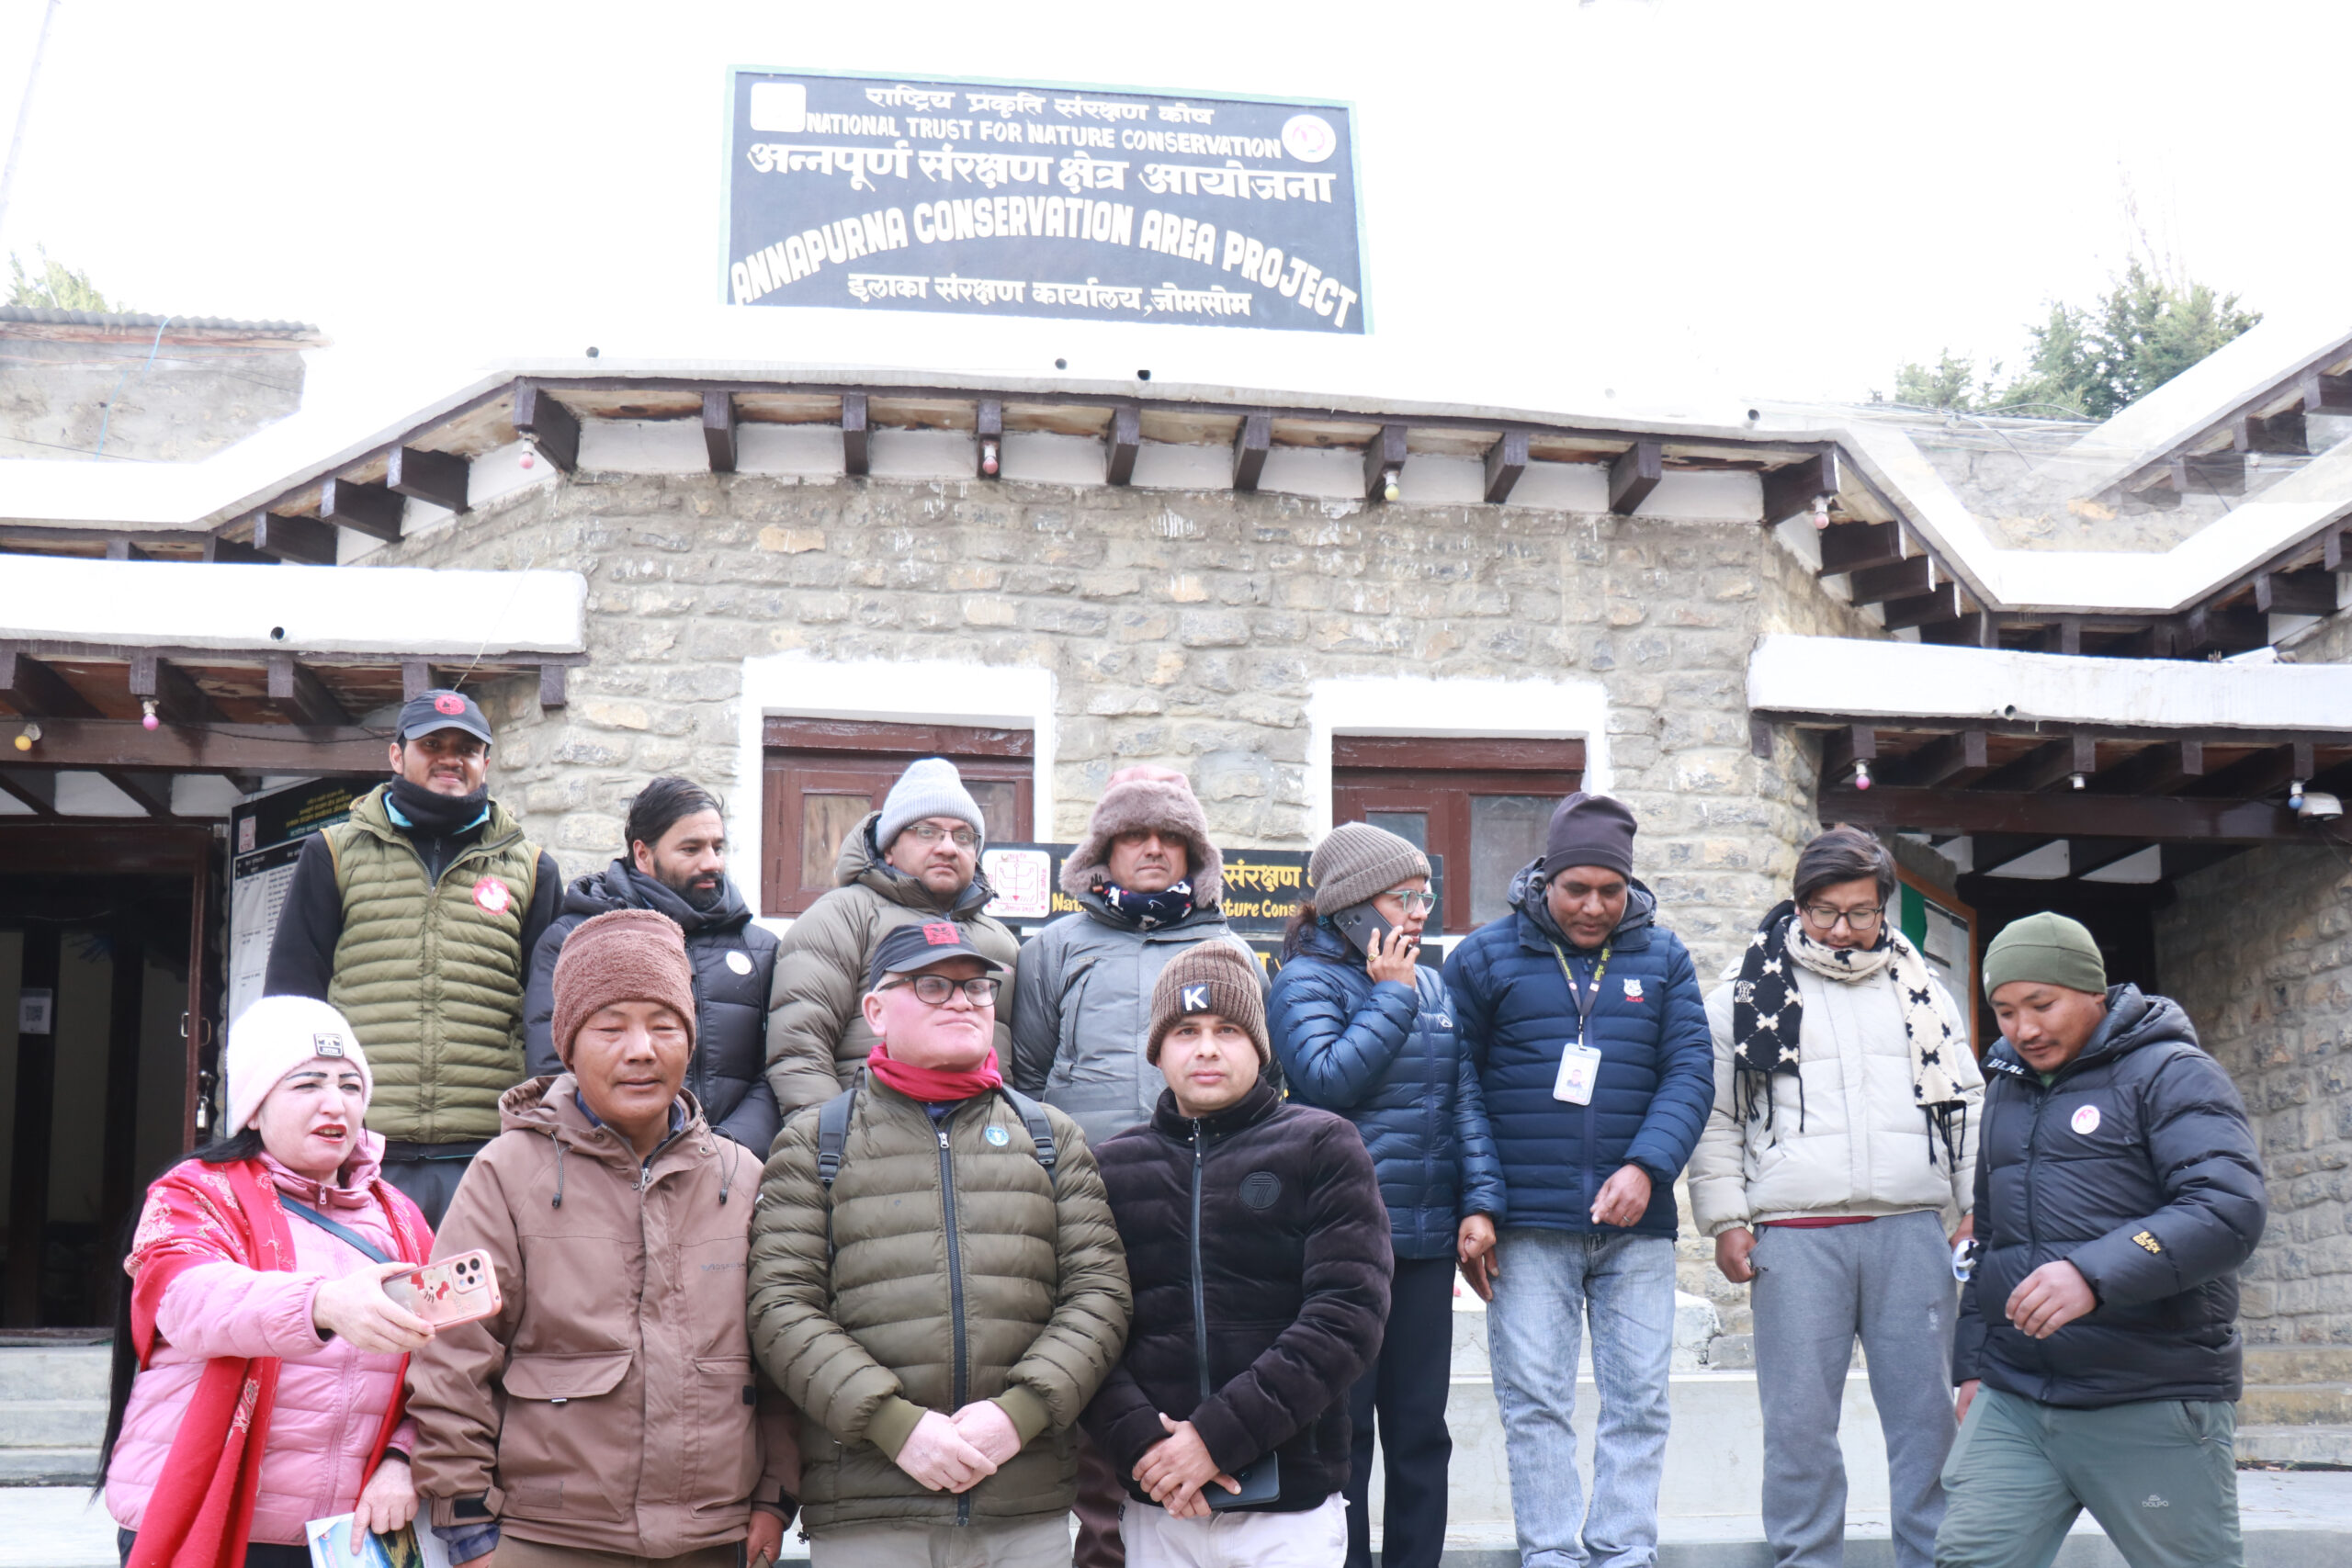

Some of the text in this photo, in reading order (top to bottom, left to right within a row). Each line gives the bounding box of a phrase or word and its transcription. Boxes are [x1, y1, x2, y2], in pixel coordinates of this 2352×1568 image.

[966, 92, 1046, 118] प्रकृति
[1054, 96, 1149, 122] संरक्षण
[1158, 102, 1215, 125] कोष
[806, 112, 1282, 159] NATIONAL TRUST FOR NATURE CONSERVATION
[747, 140, 1337, 203] अन्नपूर्ण संरक्षण क्षेत्र आयोजना
[730, 196, 1358, 328] ANNAPURNA CONSERVATION AREA PROJECT
[847, 273, 929, 302] इलाका
[934, 273, 1025, 305] संरक्षण
[1183, 987, 1208, 1011] K
